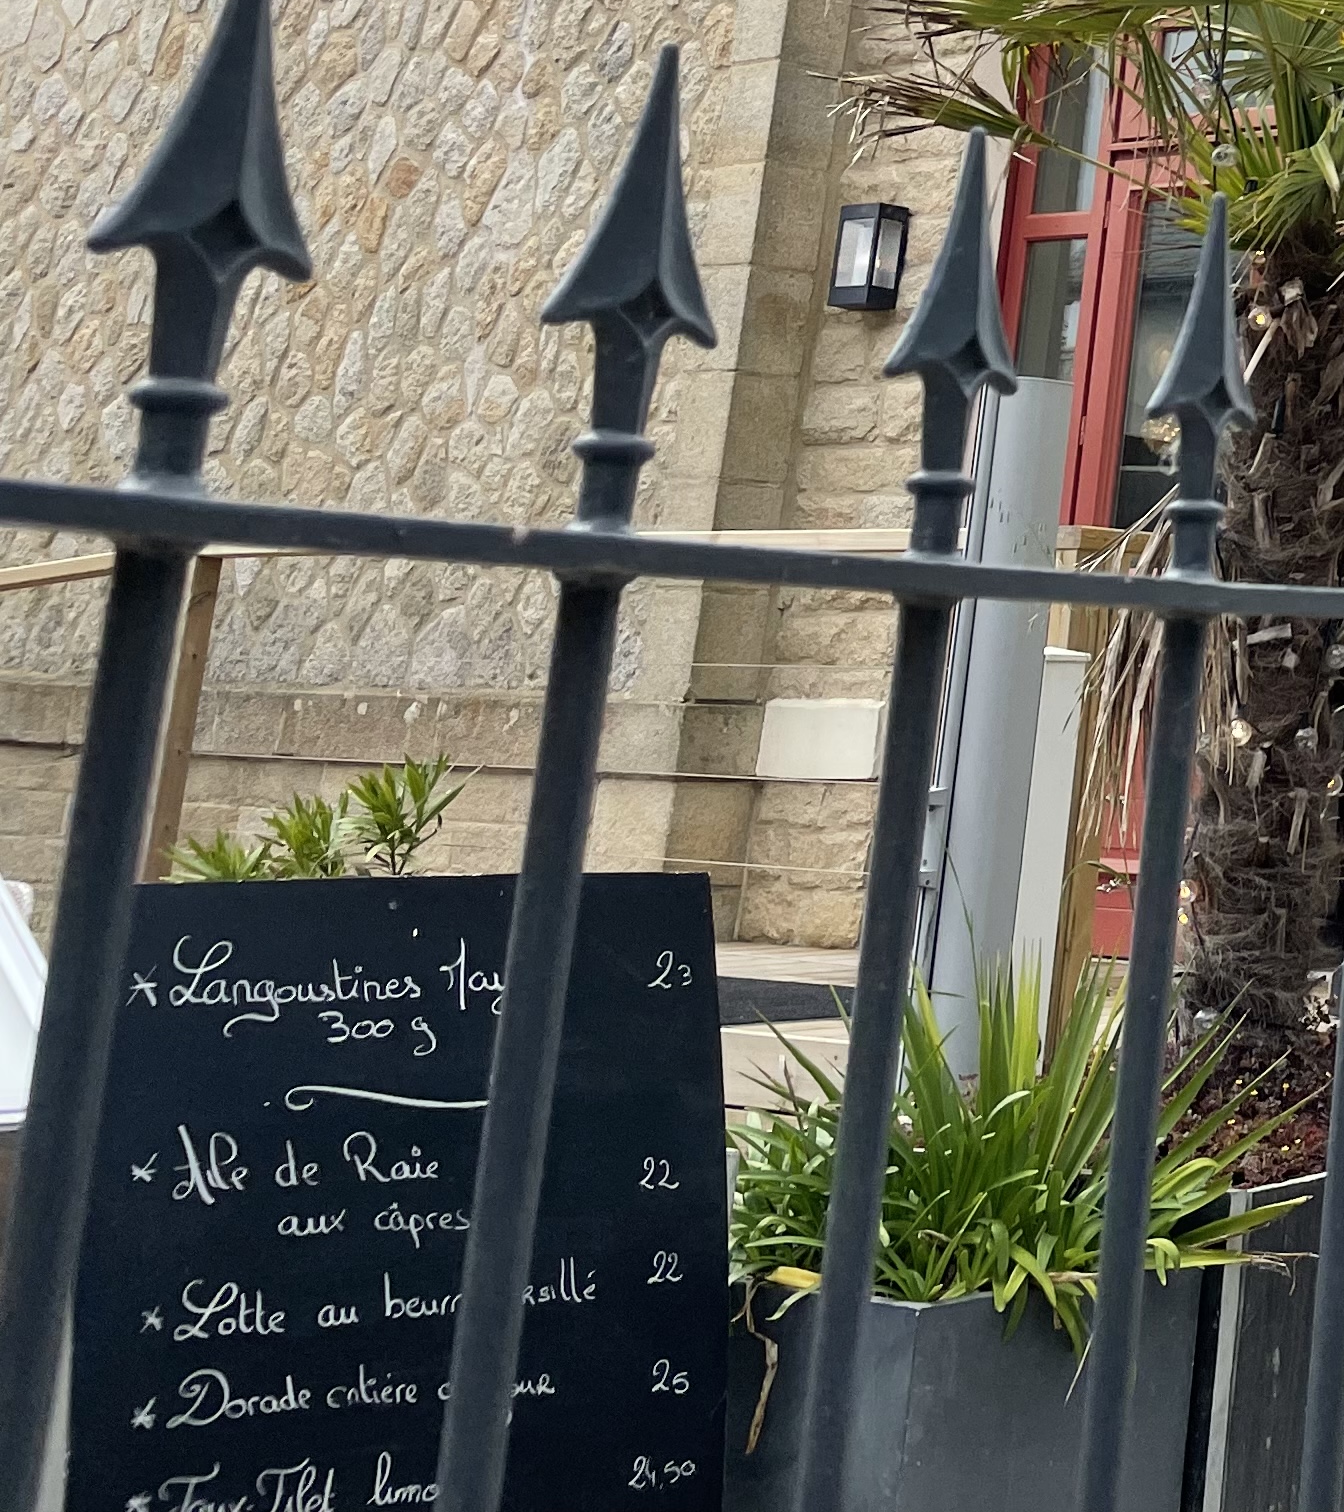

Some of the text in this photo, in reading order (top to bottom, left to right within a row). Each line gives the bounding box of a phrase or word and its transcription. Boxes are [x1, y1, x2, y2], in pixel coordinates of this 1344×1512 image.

[169, 935, 421, 1037] Langoustines
[647, 950, 692, 988] 23
[318, 1010, 436, 1056] 300 g
[275, 1140, 319, 1187] de
[343, 1131, 439, 1183] Raie
[638, 1156, 680, 1190] 22
[277, 1208, 347, 1236] aux
[173, 1279, 286, 1341] Lotte
[317, 1302, 360, 1327] au
[384, 1271, 463, 1318] beurr
[647, 1250, 683, 1284] 22
[166, 1368, 310, 1429] Dorade
[651, 1359, 690, 1394] 25
